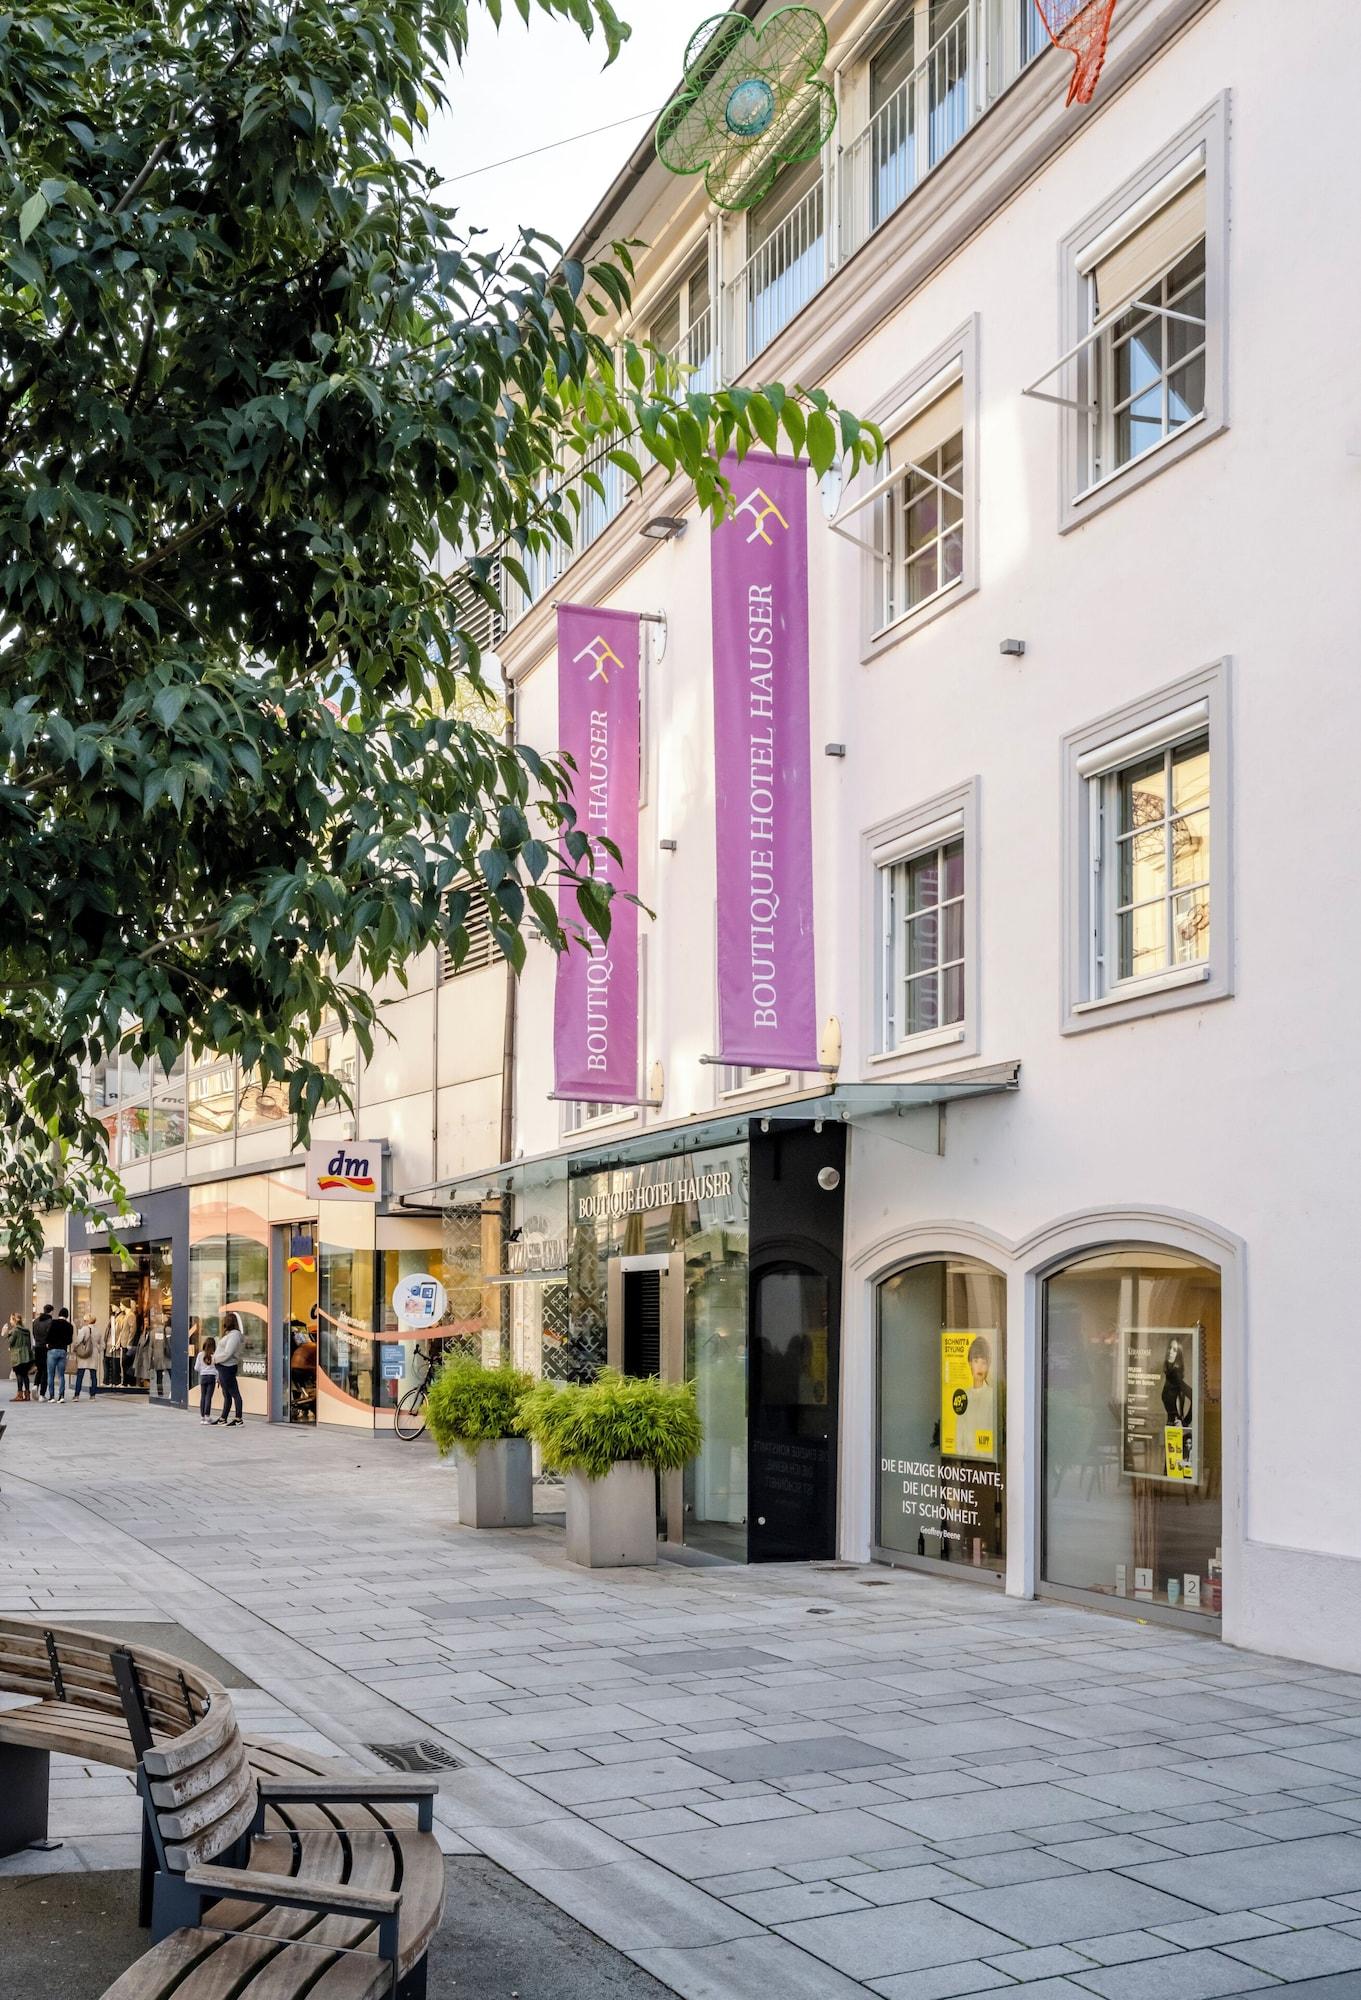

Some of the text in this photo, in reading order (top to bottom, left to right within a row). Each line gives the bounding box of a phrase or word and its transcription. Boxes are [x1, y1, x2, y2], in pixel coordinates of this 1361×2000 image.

[589, 710, 608, 821] HAUSER
[748, 584, 780, 1029] BOUTIQUE HOTEL HAUSER
[328, 1150, 369, 1176] dm
[578, 1171, 731, 1219] BOUTIQUE HOTEL HAUSER
[881, 1458, 1004, 1490] DIE EINZIGE KONSTANTE,
[903, 1481, 978, 1507] DIE ICH KENNE,
[902, 1500, 981, 1526] IST SCHÖNHEIT.
[920, 1525, 960, 1540] Geoffrey Beene
[1141, 1574, 1147, 1587] 1
[1188, 1580, 1197, 1594] 2
